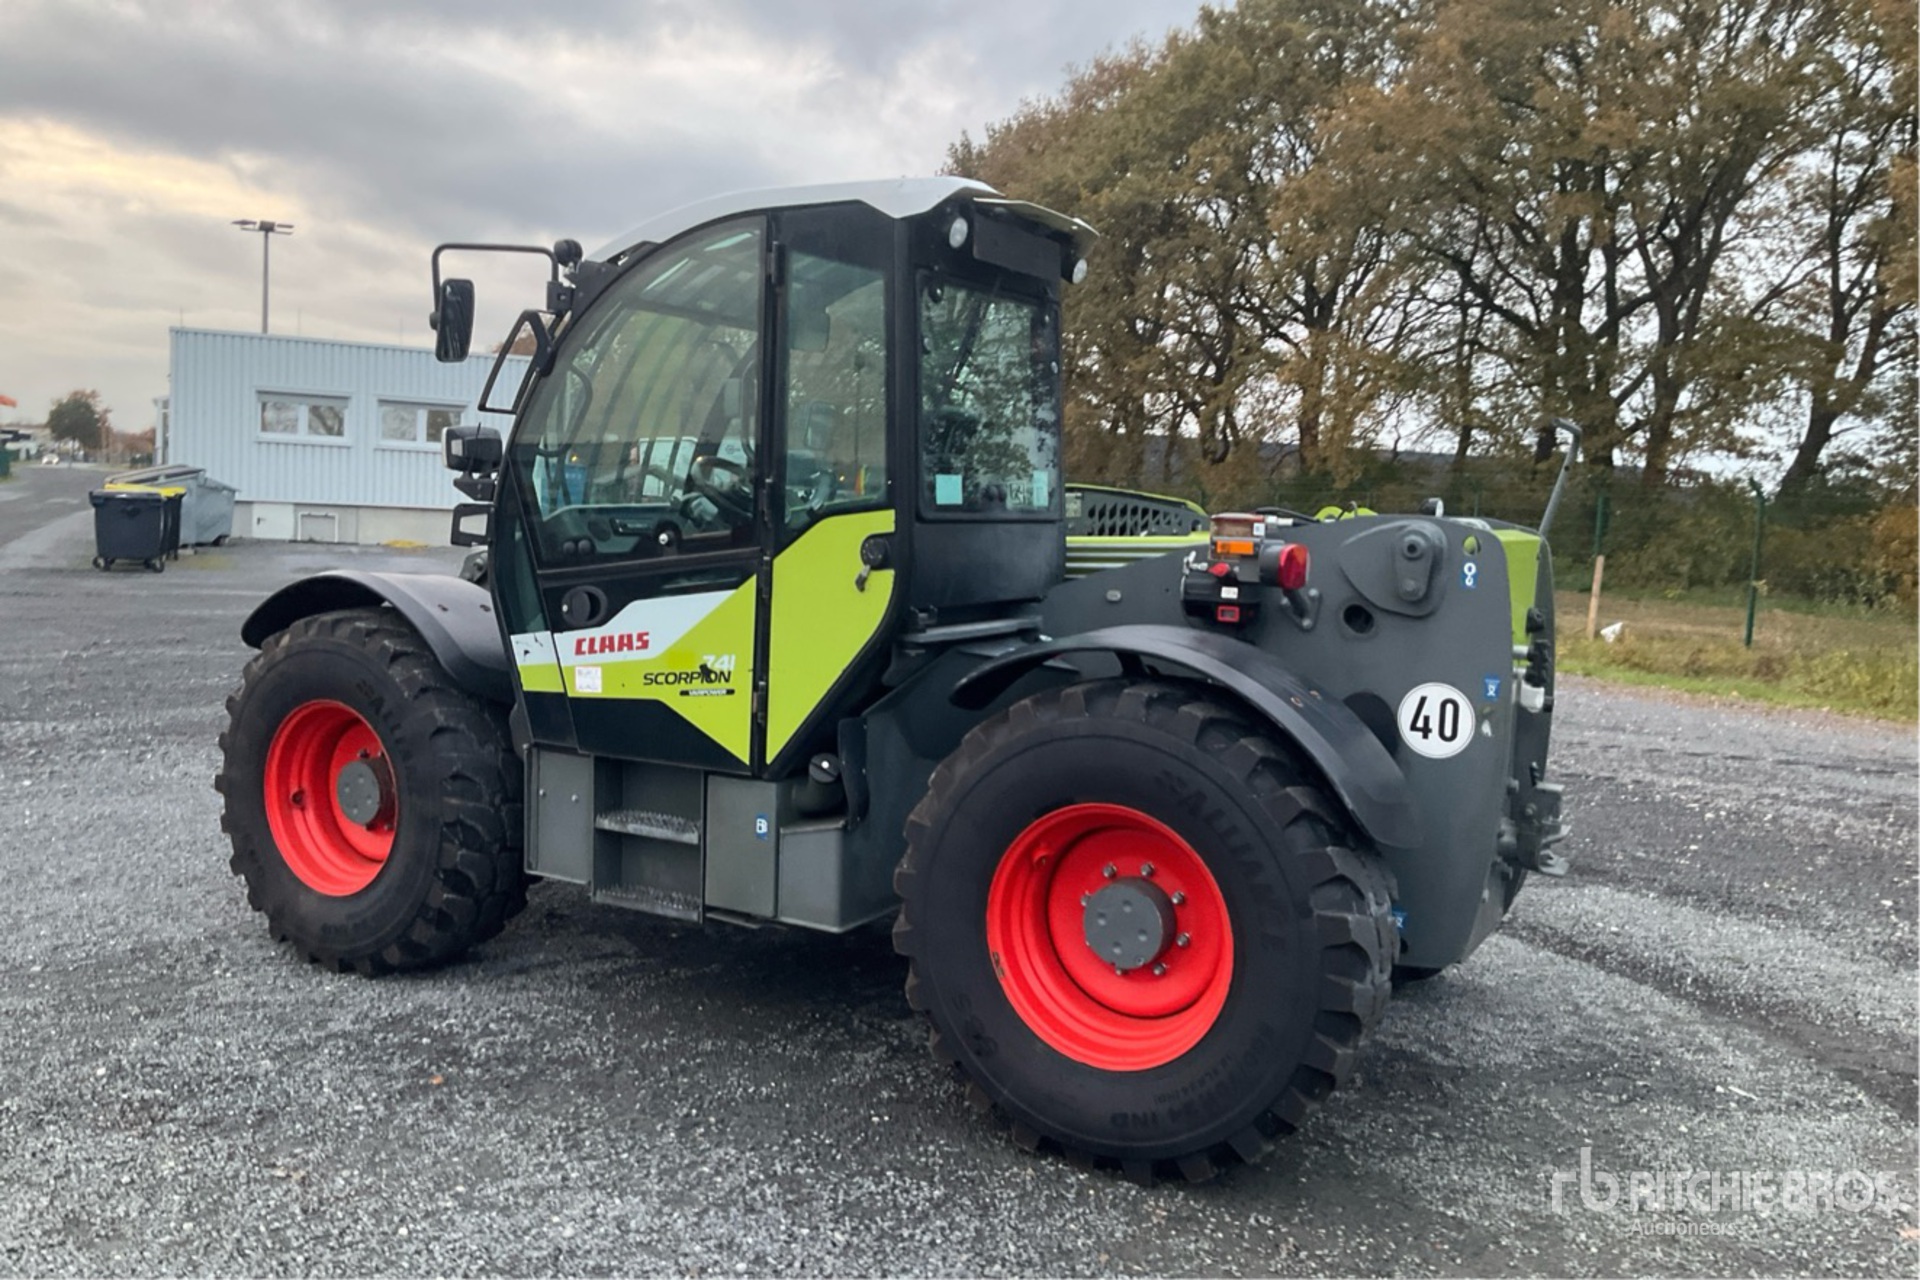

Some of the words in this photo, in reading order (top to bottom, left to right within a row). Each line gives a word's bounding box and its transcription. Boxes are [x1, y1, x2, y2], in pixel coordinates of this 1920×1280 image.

[574, 631, 650, 656] CLAAS
[642, 669, 731, 686] SCORPION
[1409, 696, 1460, 743] 40
